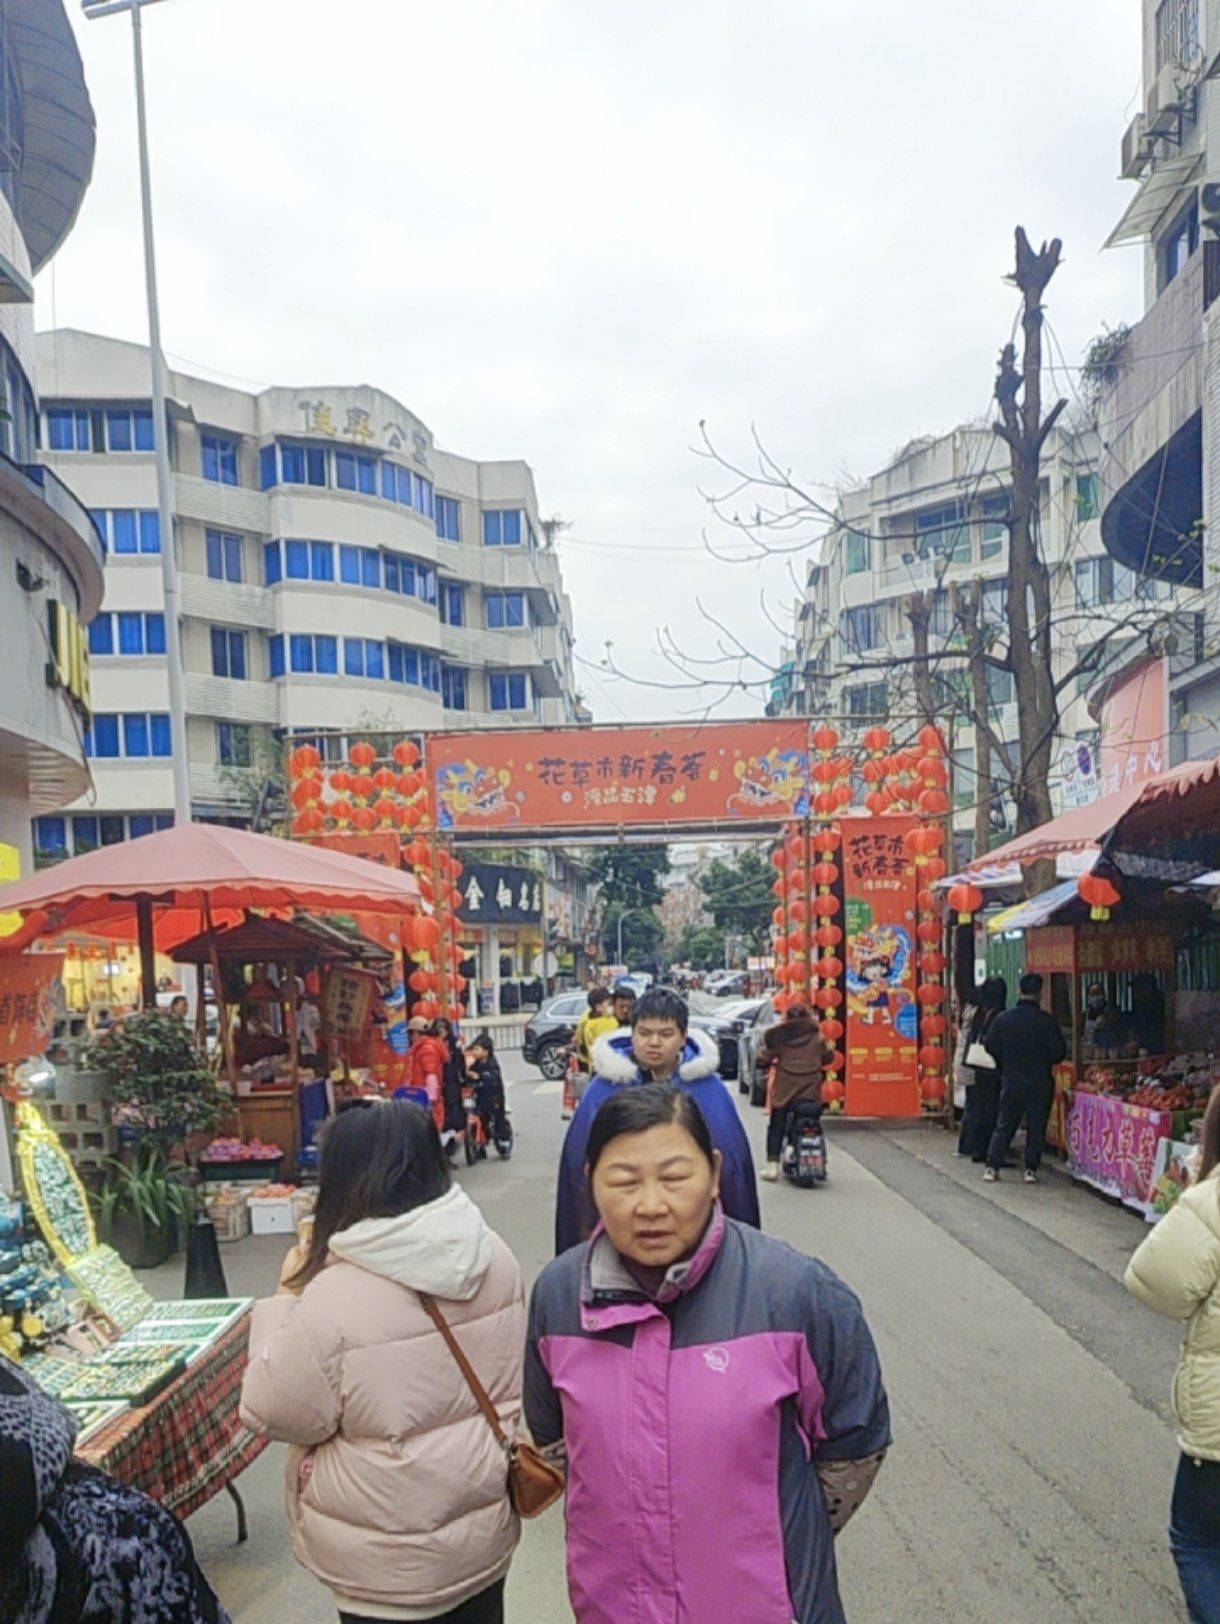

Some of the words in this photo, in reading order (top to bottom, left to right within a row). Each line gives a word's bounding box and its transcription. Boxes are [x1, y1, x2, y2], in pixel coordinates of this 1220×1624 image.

[537, 750, 707, 787] 花草市新春荟
[849, 834, 904, 859] 花草市
[852, 855, 910, 878] 新春荟
